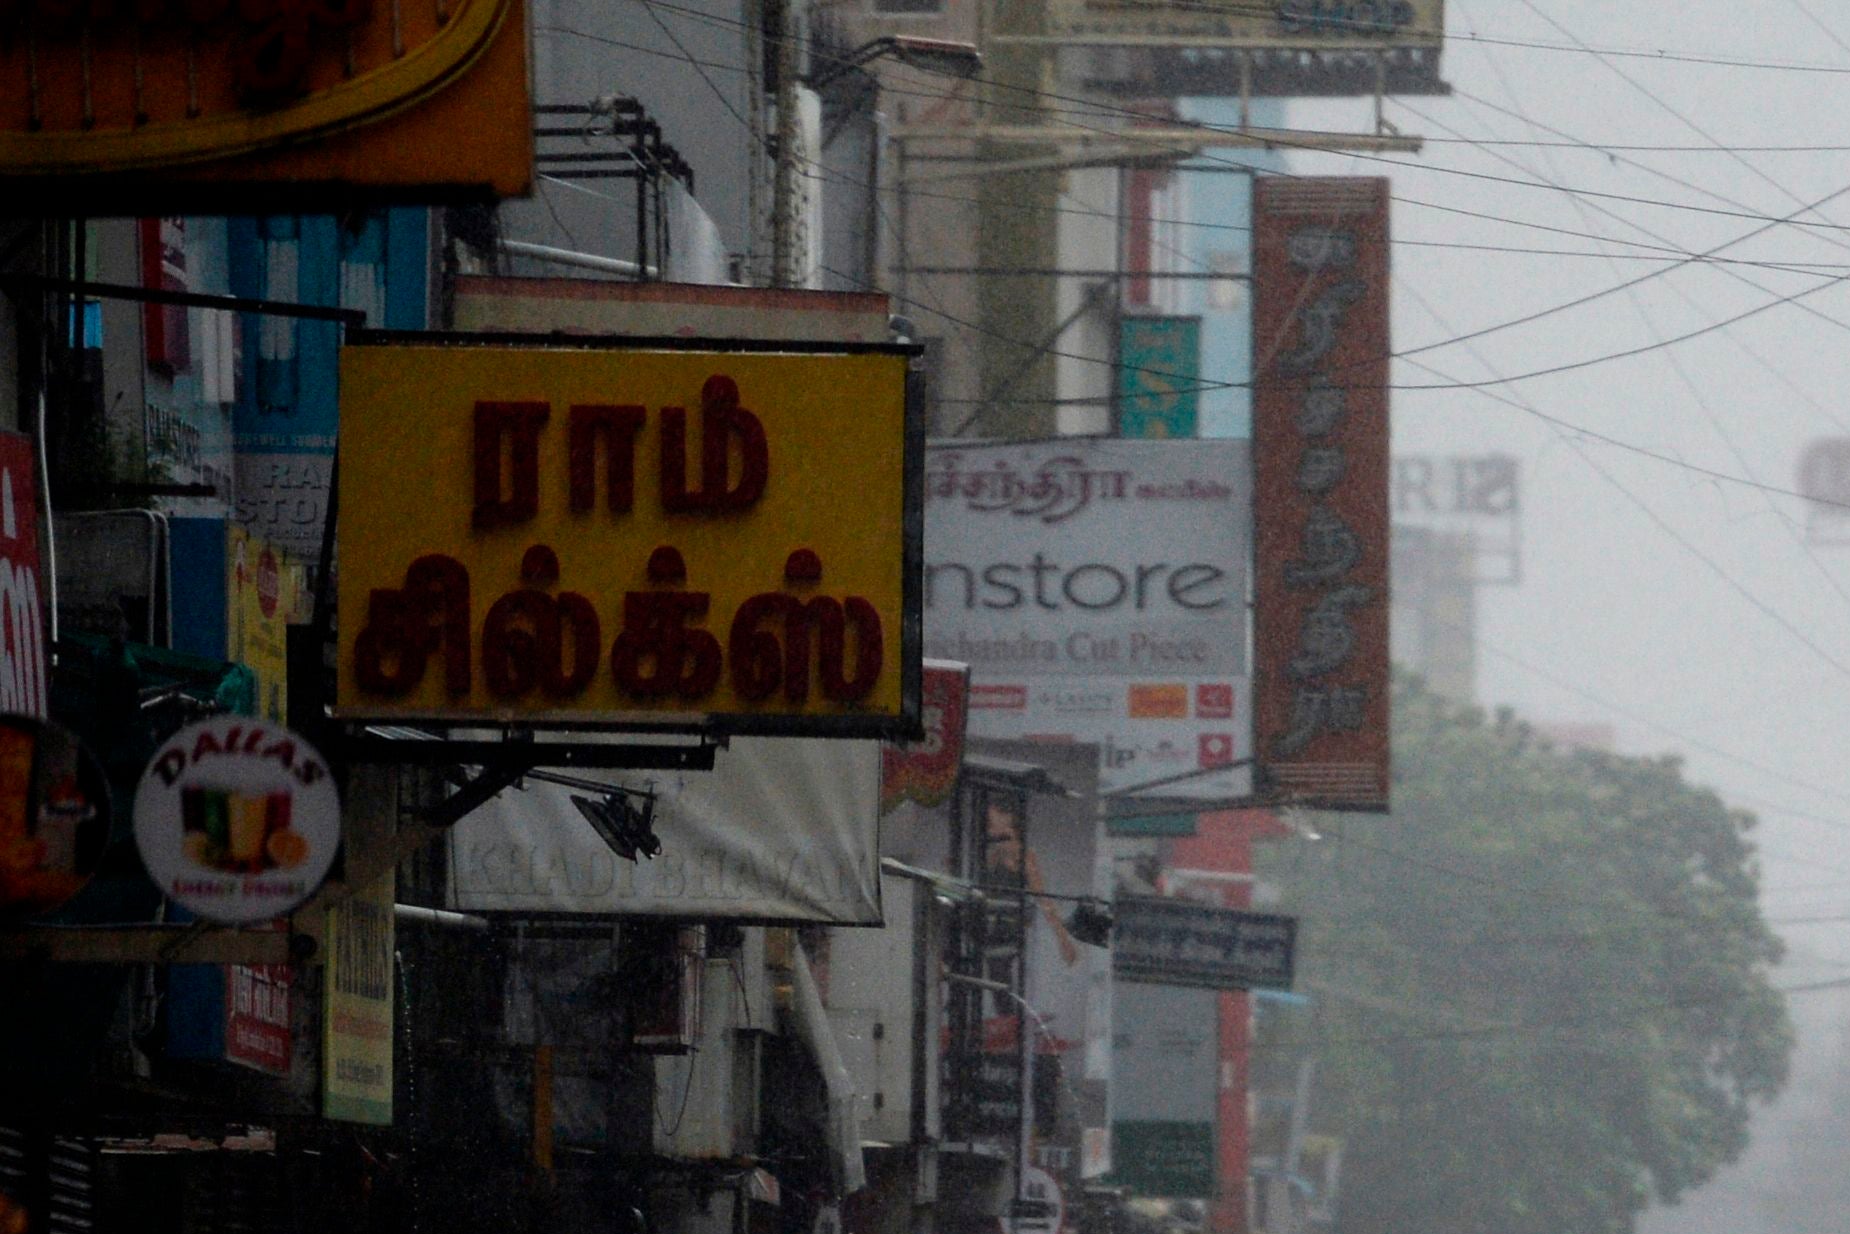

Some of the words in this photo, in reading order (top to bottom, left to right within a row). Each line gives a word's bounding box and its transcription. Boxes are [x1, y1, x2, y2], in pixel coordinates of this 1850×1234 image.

[473, 376, 769, 527] ராம்
[925, 456, 1131, 524] ச்சந்திரா
[355, 545, 884, 701] சில்க்ஸ்
[152, 726, 325, 786] DALLAS
